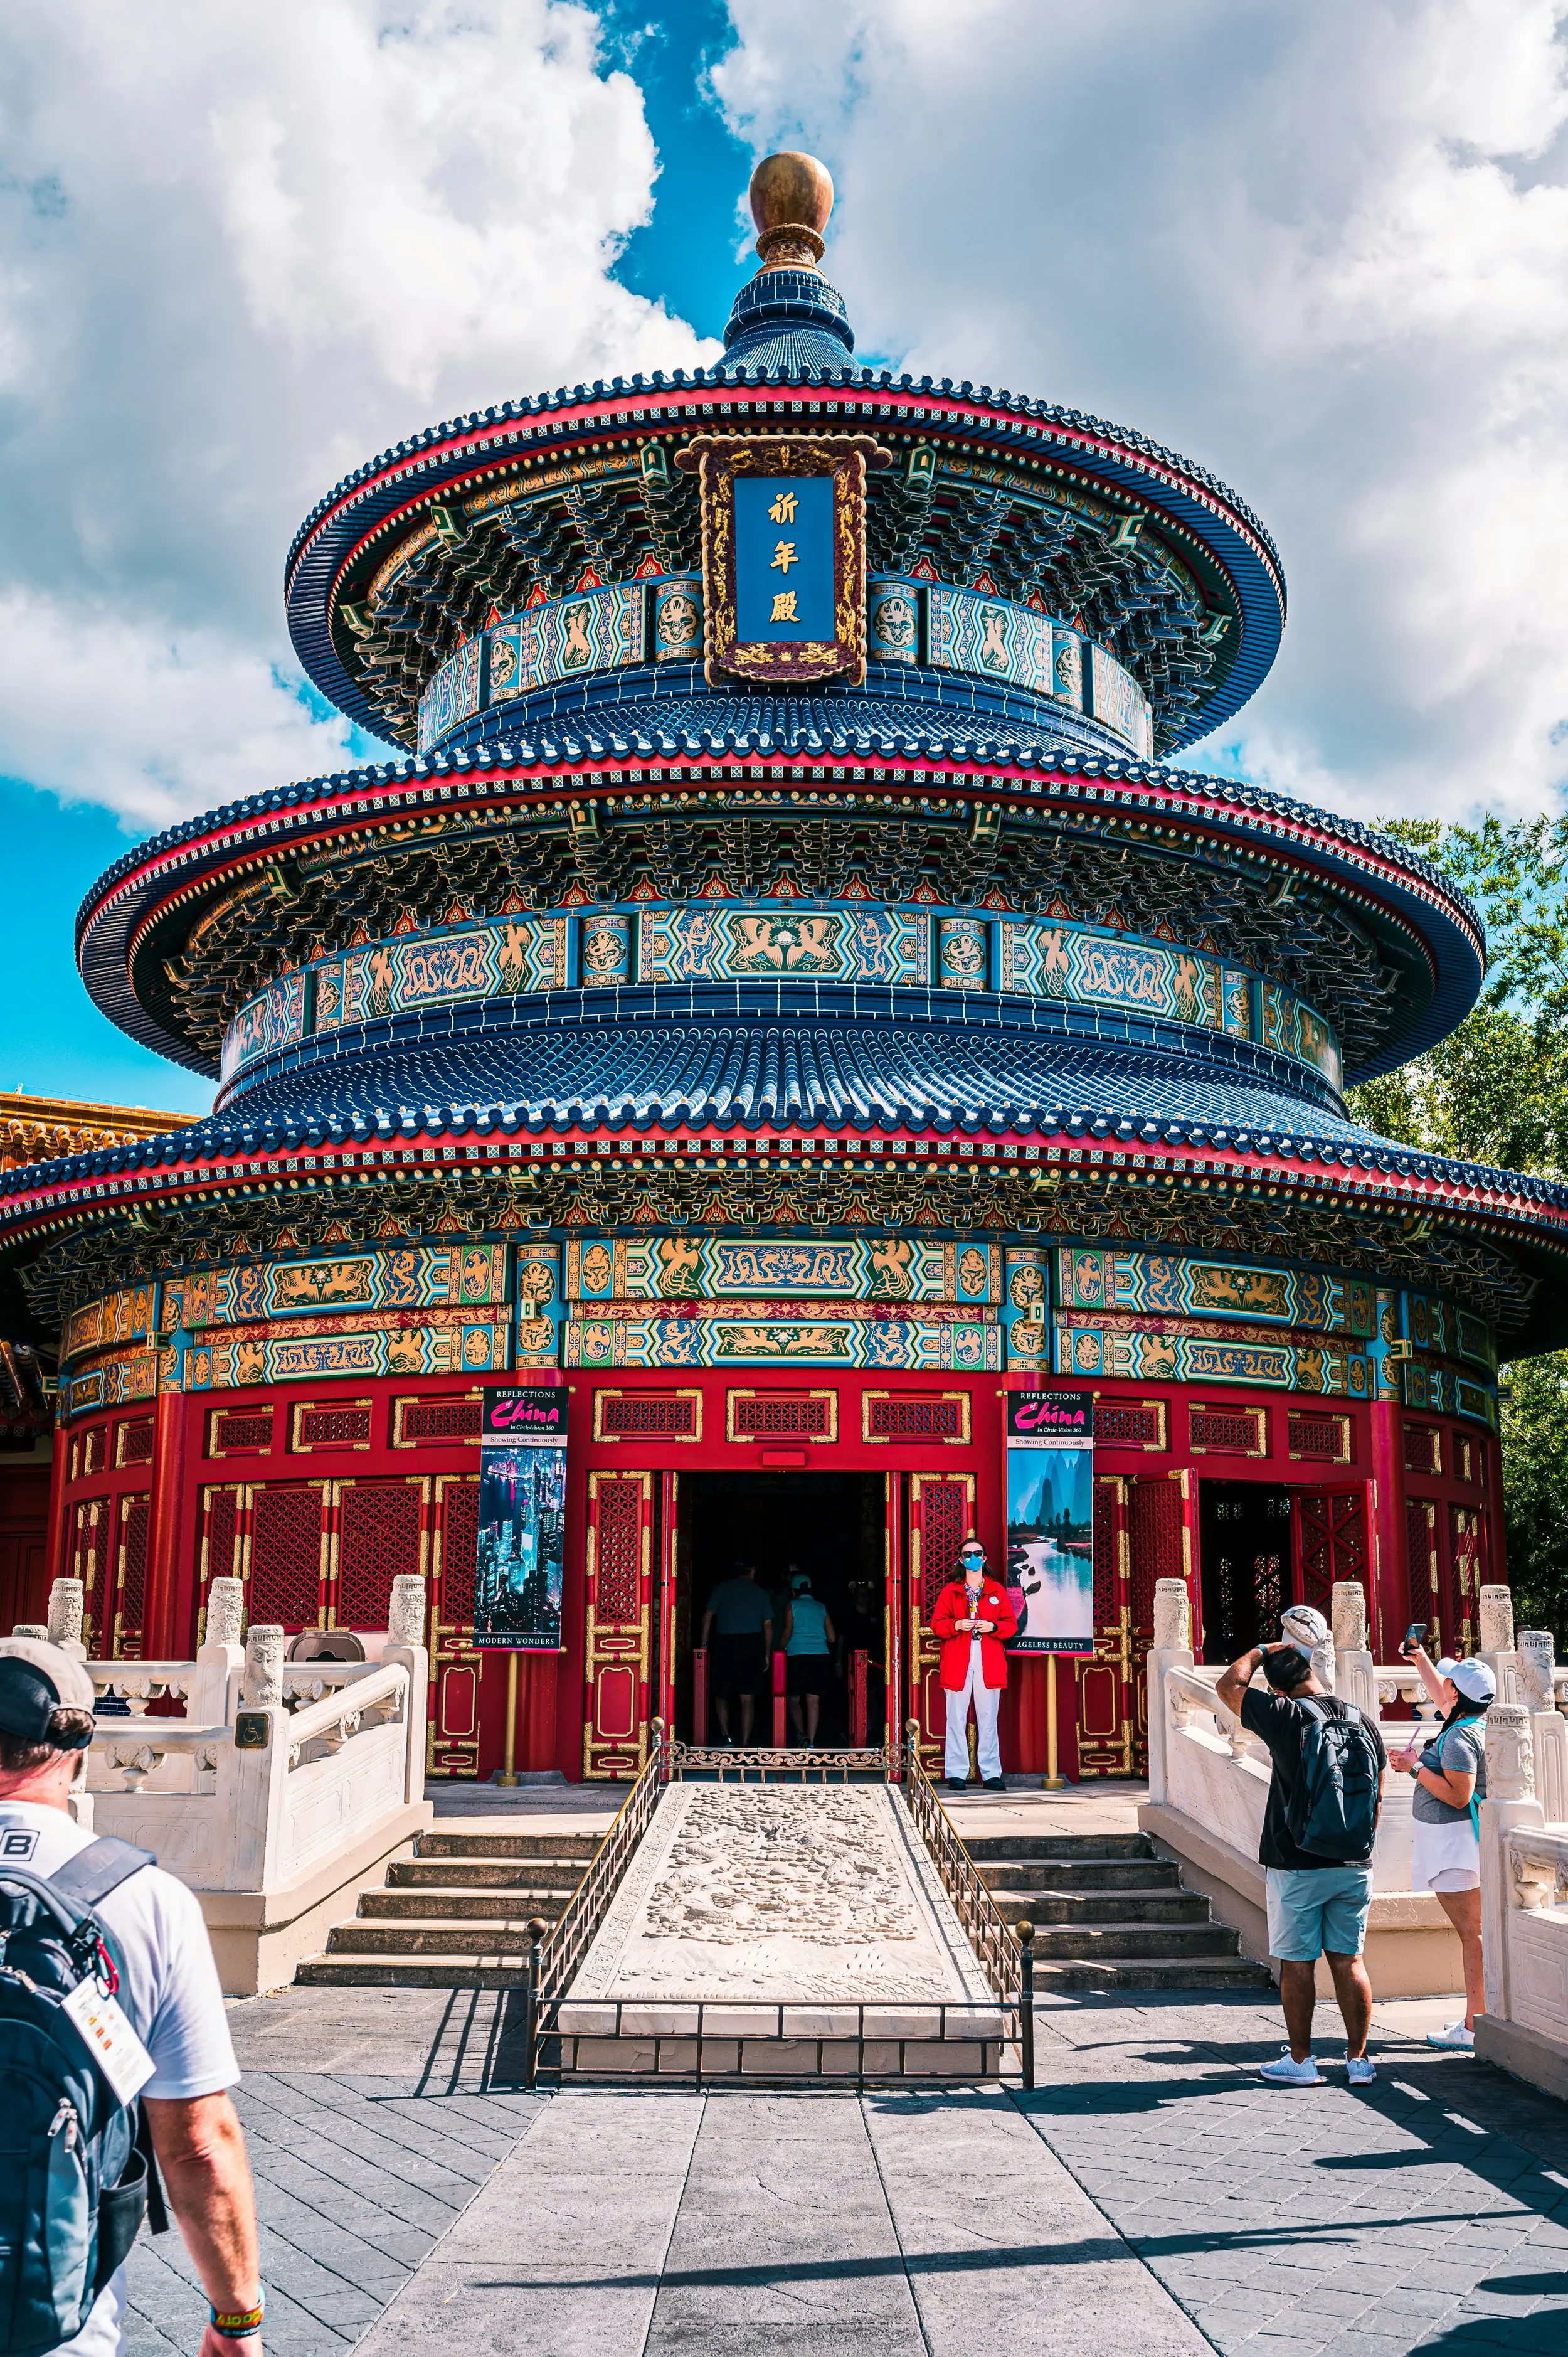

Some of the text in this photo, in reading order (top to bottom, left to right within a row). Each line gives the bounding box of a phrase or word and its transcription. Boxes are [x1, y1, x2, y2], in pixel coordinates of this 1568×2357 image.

[767, 492, 802, 623] 祈年殿
[490, 1400, 559, 1427] of China
[1015, 1402, 1085, 1429] of China
[517, 1437, 558, 1445] Continuously
[1044, 1439, 1085, 1447] Continuously
[3, 1835, 32, 1855] B
